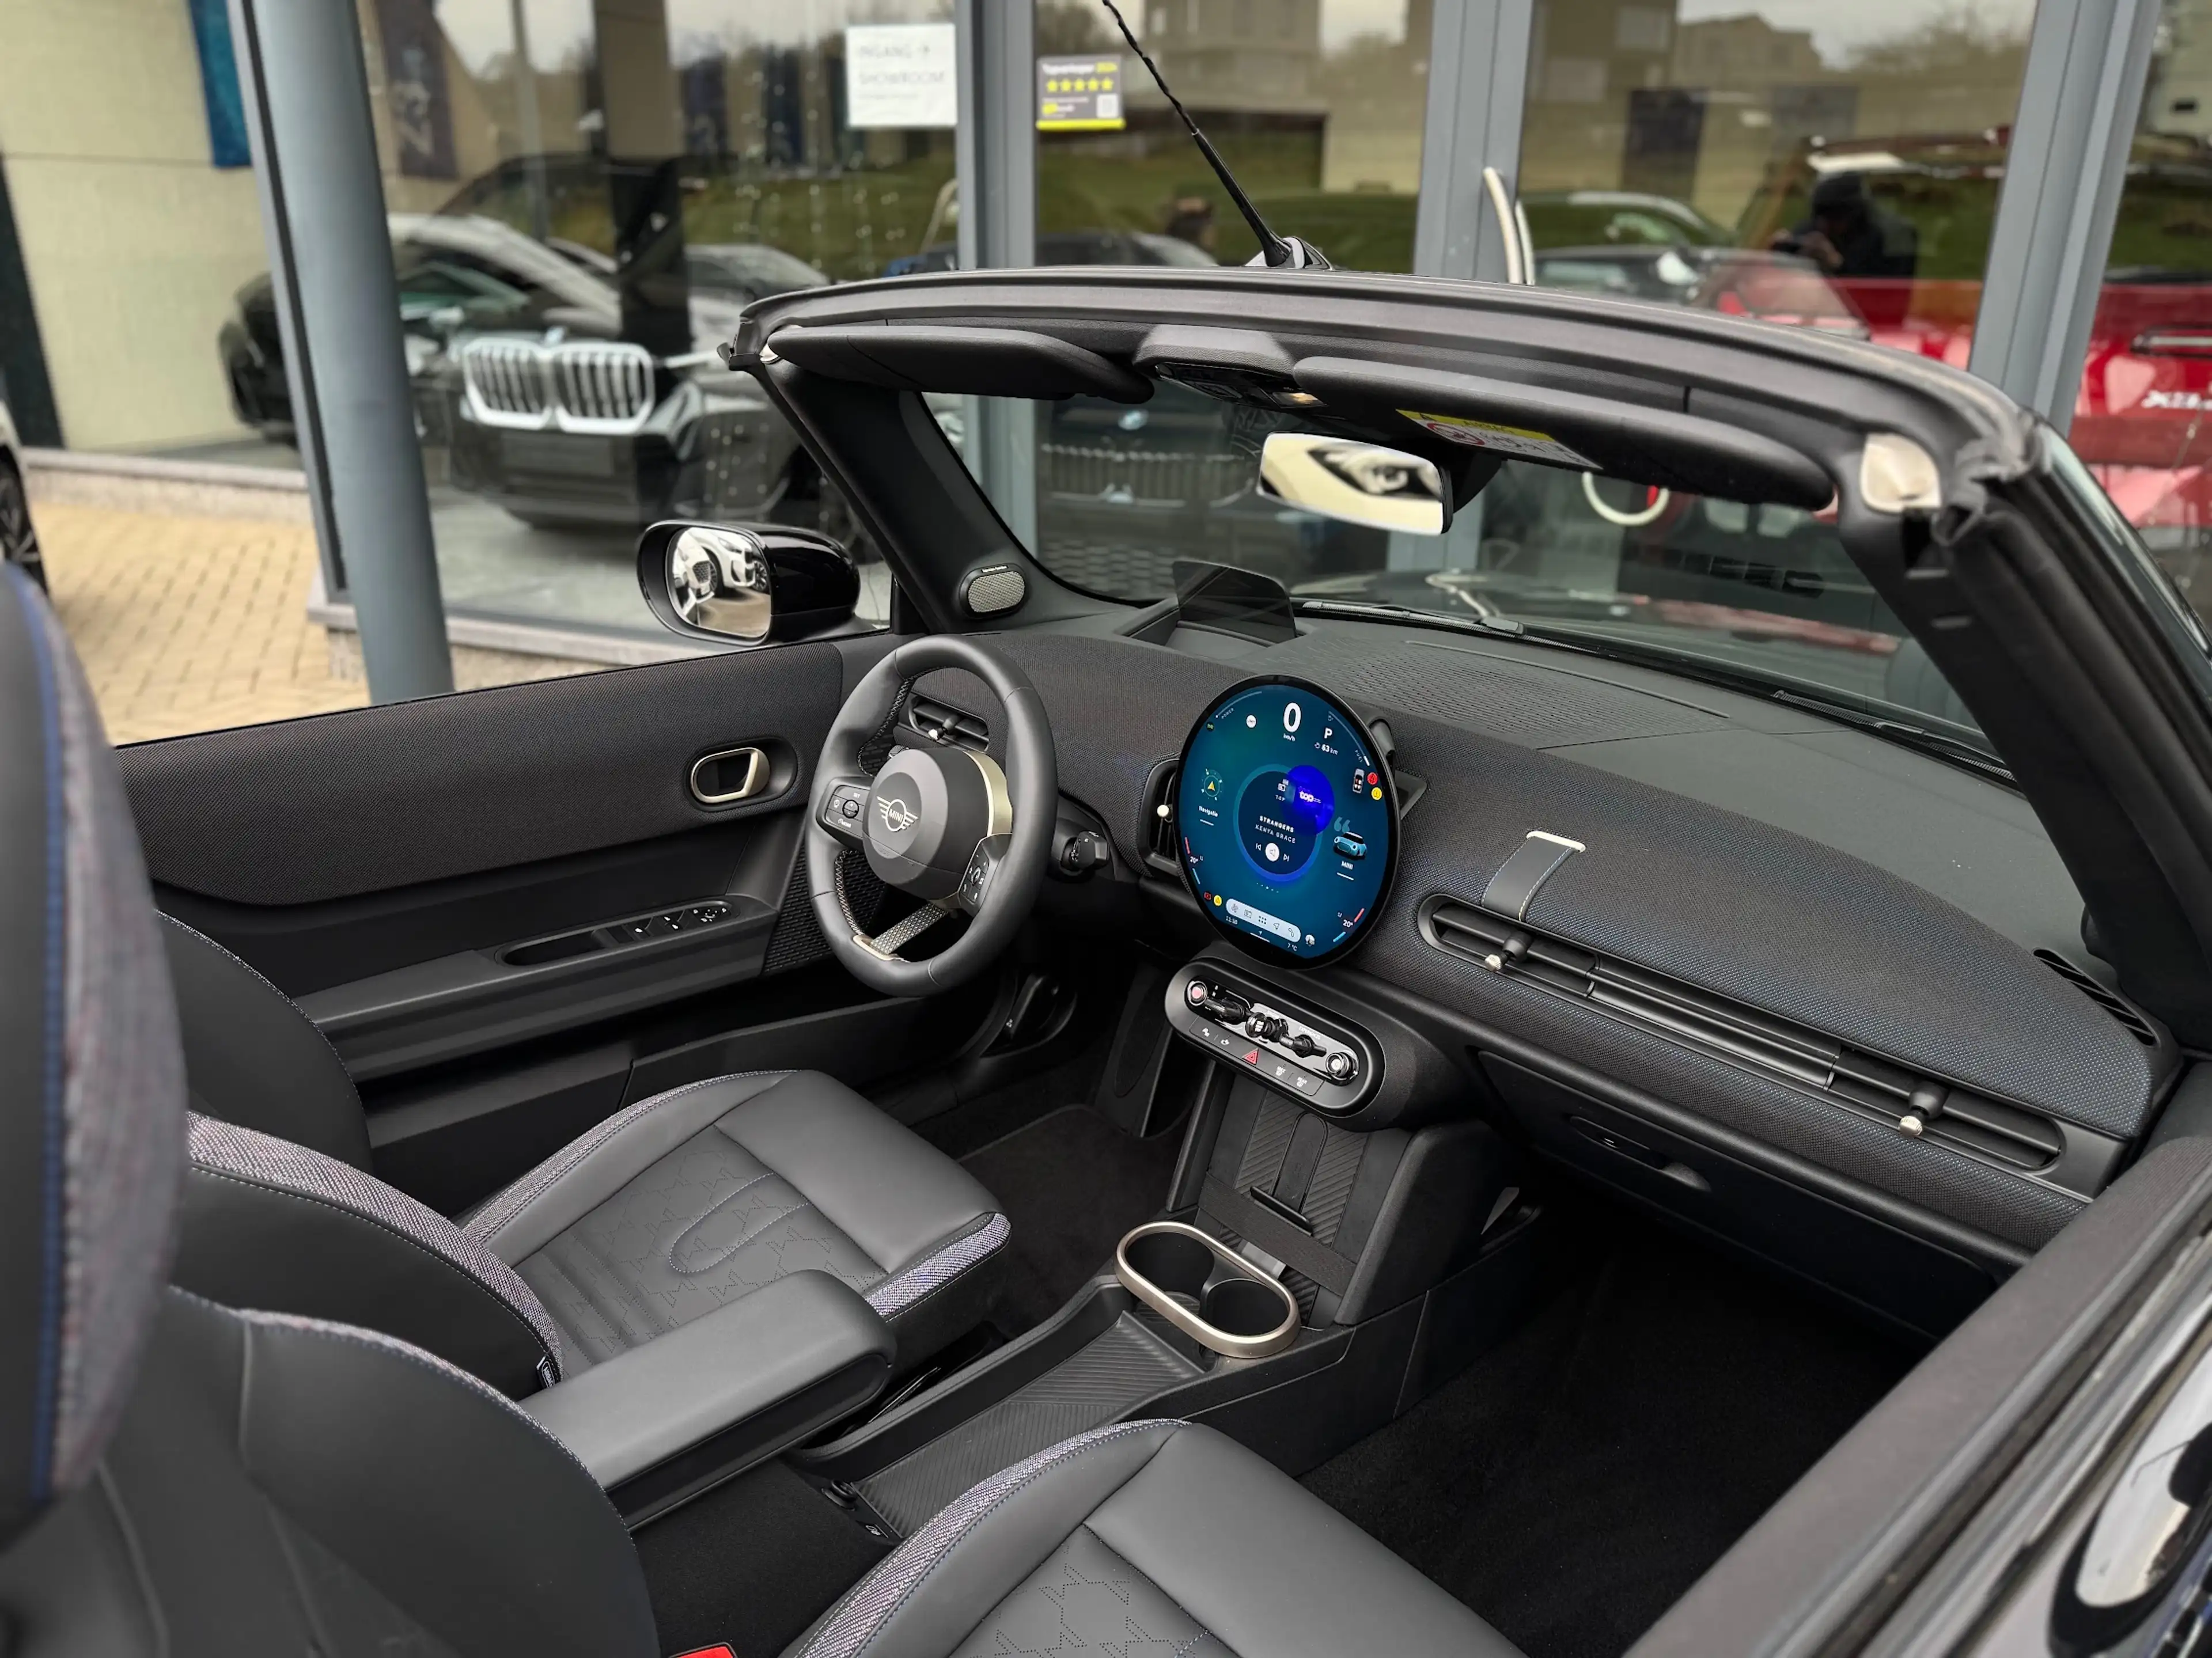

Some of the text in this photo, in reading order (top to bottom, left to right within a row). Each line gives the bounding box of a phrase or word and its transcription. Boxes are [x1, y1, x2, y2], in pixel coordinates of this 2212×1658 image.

[1283, 702, 1302, 733] 0
[1283, 733, 1296, 742] km/h
[1324, 727, 1333, 739] P
[1354, 749, 1363, 763] FUEL
[888, 807, 904, 824] MINI
[1259, 815, 1294, 833] STRANGERS
[1255, 824, 1296, 844] KENYA GRACE
